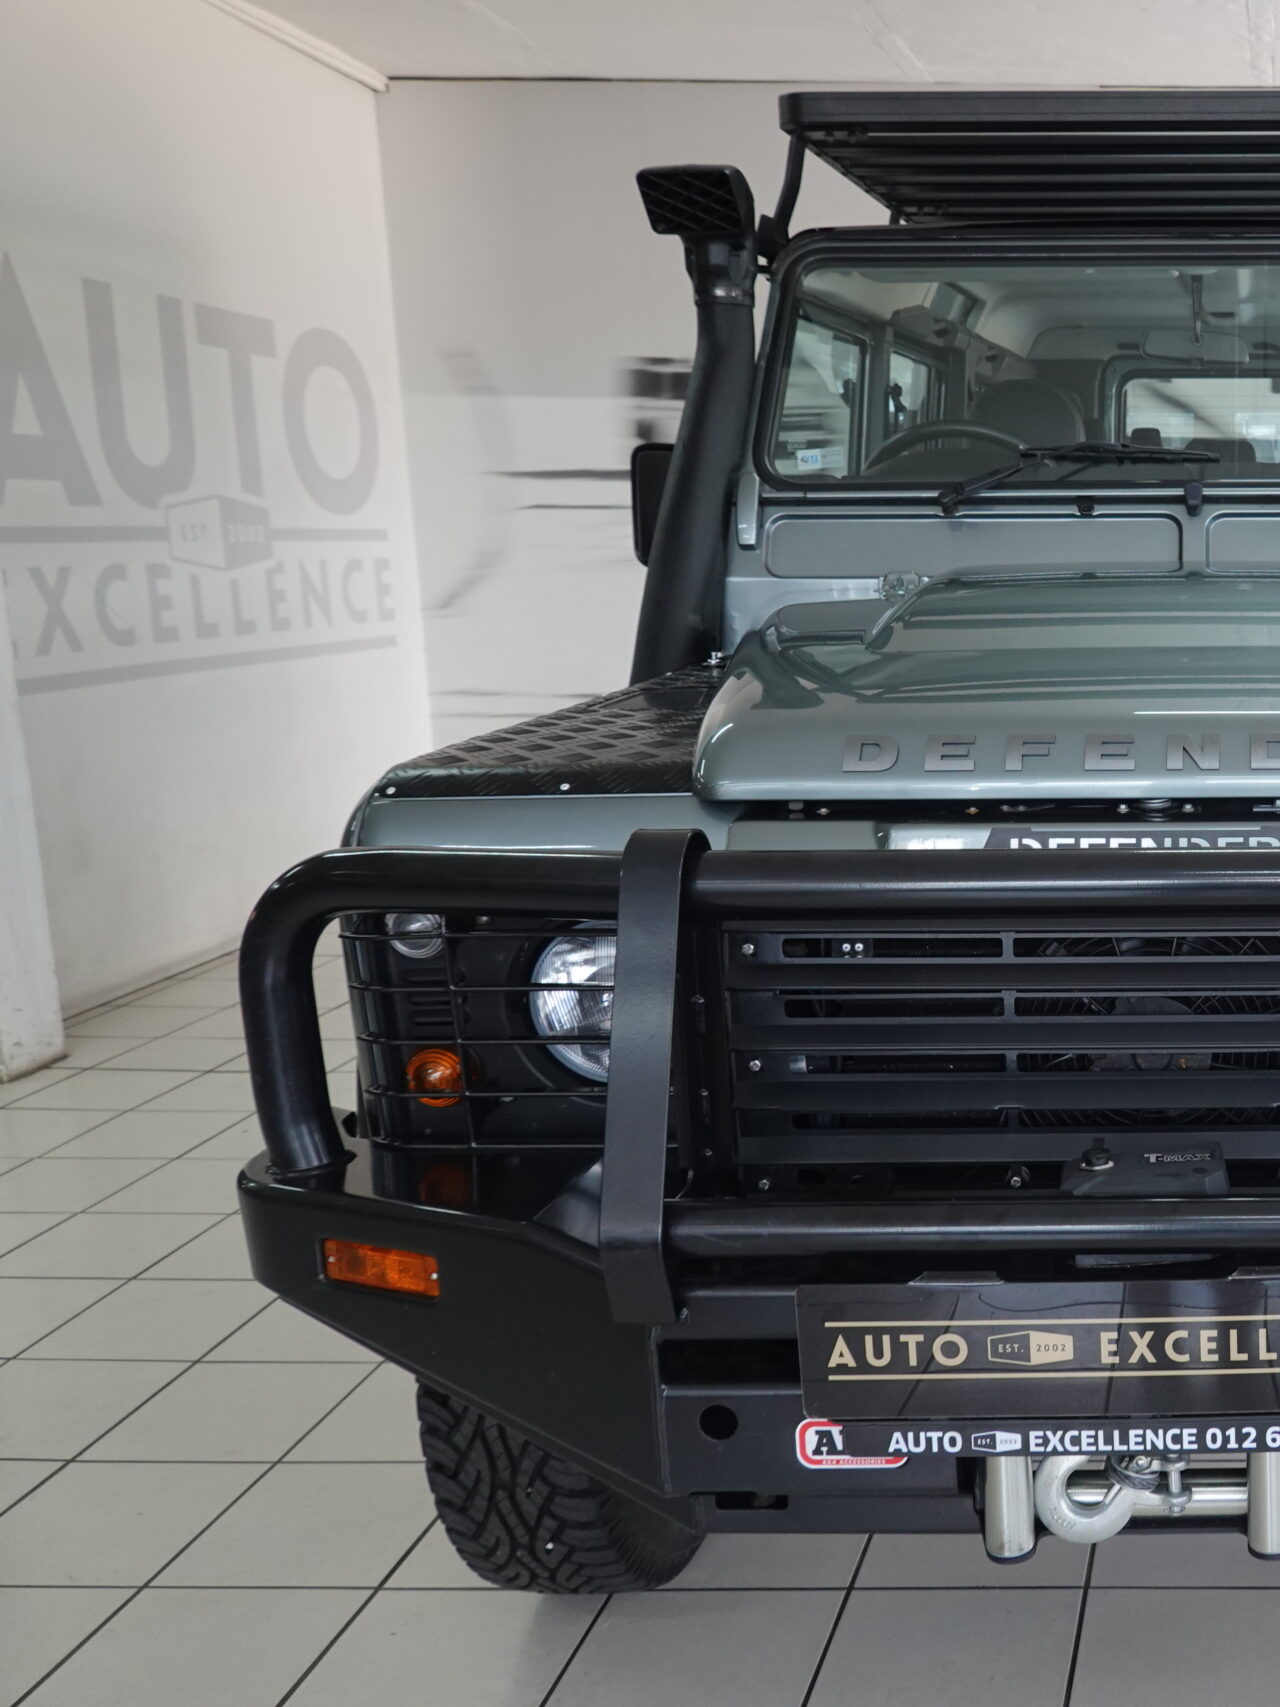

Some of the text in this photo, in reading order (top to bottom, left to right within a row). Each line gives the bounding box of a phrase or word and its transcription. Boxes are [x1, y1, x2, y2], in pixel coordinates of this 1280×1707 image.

[0, 251, 380, 516] AUTO
[1, 557, 397, 659] XCELLENCE
[1143, 1153, 1211, 1163] T-MAX
[827, 1333, 968, 1368] AUTO
[997, 1343, 1024, 1353] EST.
[1036, 1343, 1067, 1353] 2002
[887, 1431, 963, 1454] AUTO
[977, 1437, 993, 1446] EST.
[1028, 1427, 1199, 1453] EXCELLENCE
[1205, 1426, 1258, 1450] 012
[838, 1458, 887, 1466] ACCESSORIES
